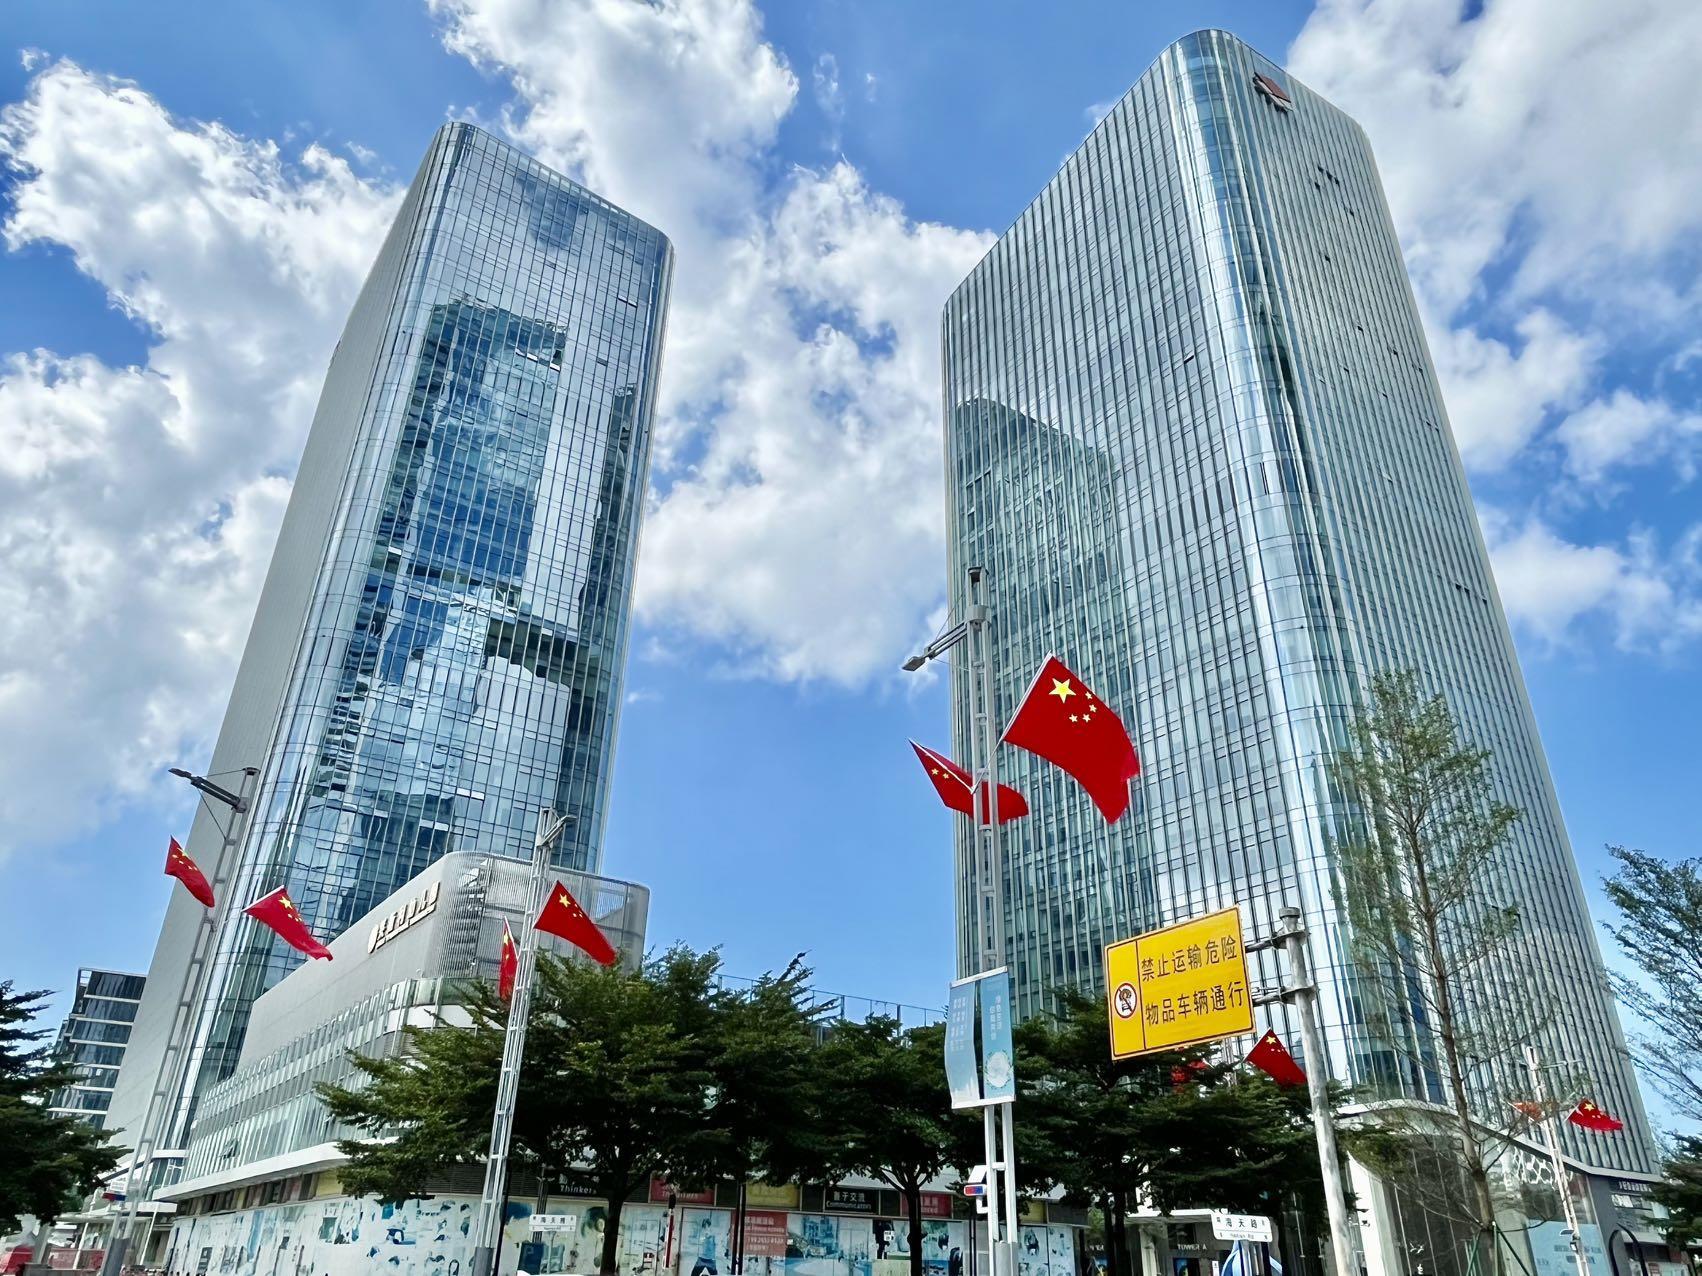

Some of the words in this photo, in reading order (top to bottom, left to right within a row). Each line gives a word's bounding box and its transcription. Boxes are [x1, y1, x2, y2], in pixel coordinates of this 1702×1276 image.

[1140, 934, 1238, 982] 禁止运输危险
[1144, 980, 1245, 1027] 物品车辆通行
